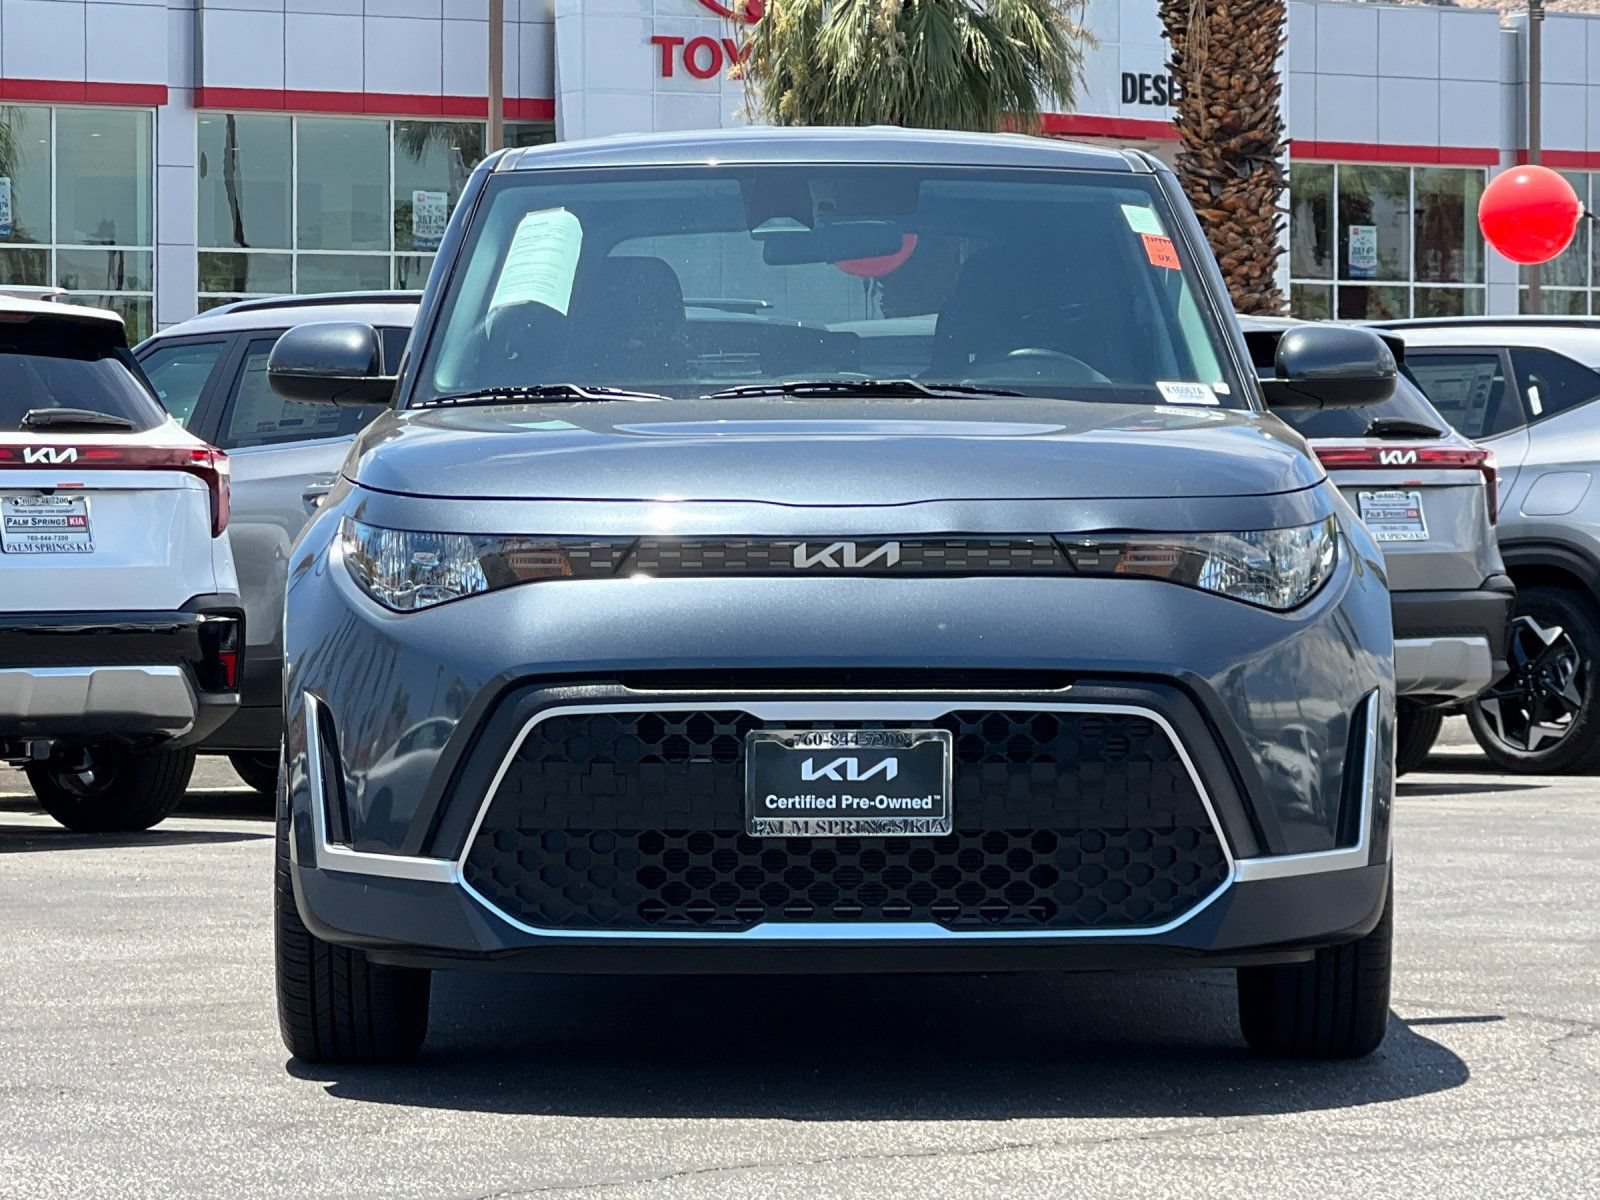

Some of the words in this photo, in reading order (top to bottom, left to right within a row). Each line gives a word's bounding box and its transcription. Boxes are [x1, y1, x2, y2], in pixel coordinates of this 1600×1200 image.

[651, 36, 753, 80] TOY
[1122, 72, 1183, 106] DESE
[6, 517, 29, 526] PALM
[31, 517, 66, 526] SPRINGS
[69, 518, 85, 526] KIA
[6, 543, 33, 552] PALM
[34, 543, 75, 552] SPRINGS
[76, 543, 95, 552] KIA
[793, 541, 900, 568] KIA
[801, 757, 898, 781] KIA
[765, 795, 836, 809] Certified
[753, 820, 809, 834] PALM
[815, 820, 906, 834] SPRINGS
[907, 820, 947, 834] KIA
